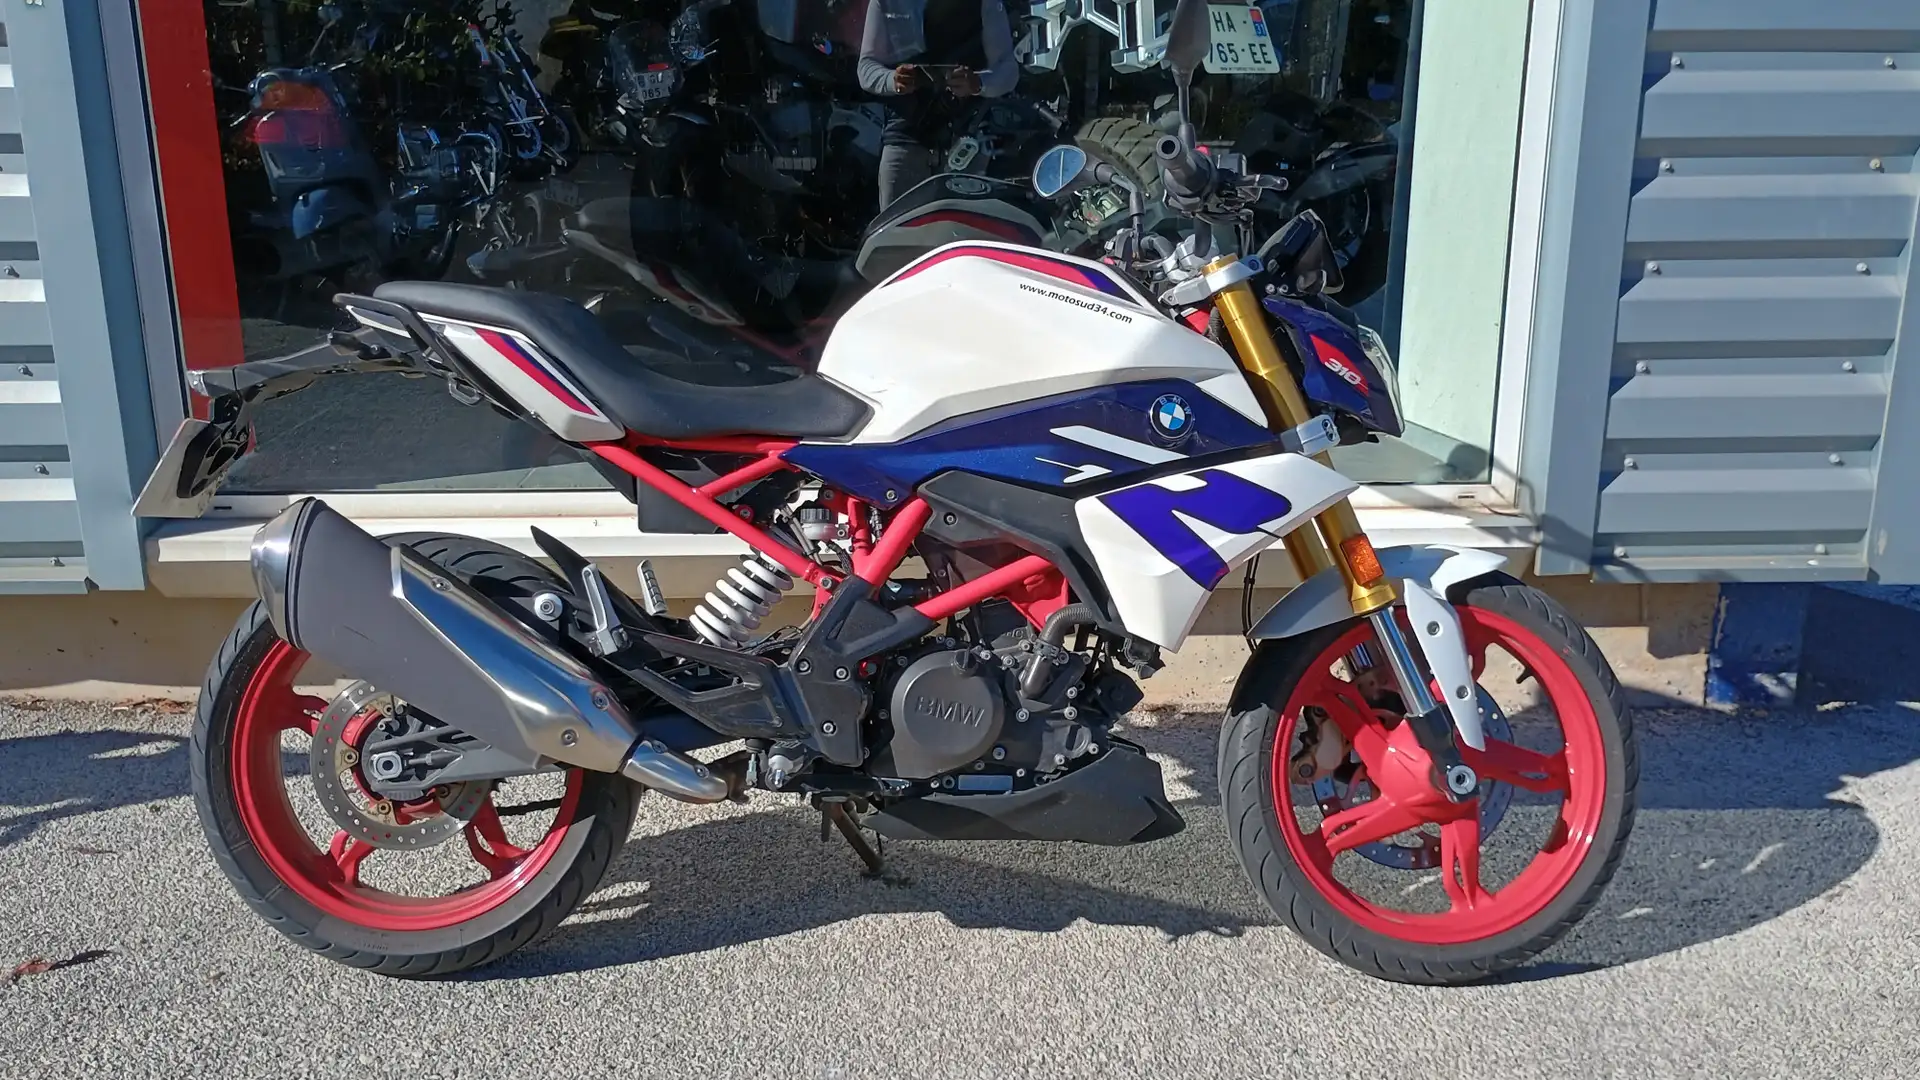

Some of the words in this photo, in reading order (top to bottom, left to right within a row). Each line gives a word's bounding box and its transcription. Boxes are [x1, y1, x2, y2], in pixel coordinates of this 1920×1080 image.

[1019, 283, 1133, 324] www.motosud34.com
[1324, 357, 1362, 385] 310
[1159, 395, 1192, 415] BMW
[914, 696, 985, 728] BMW
